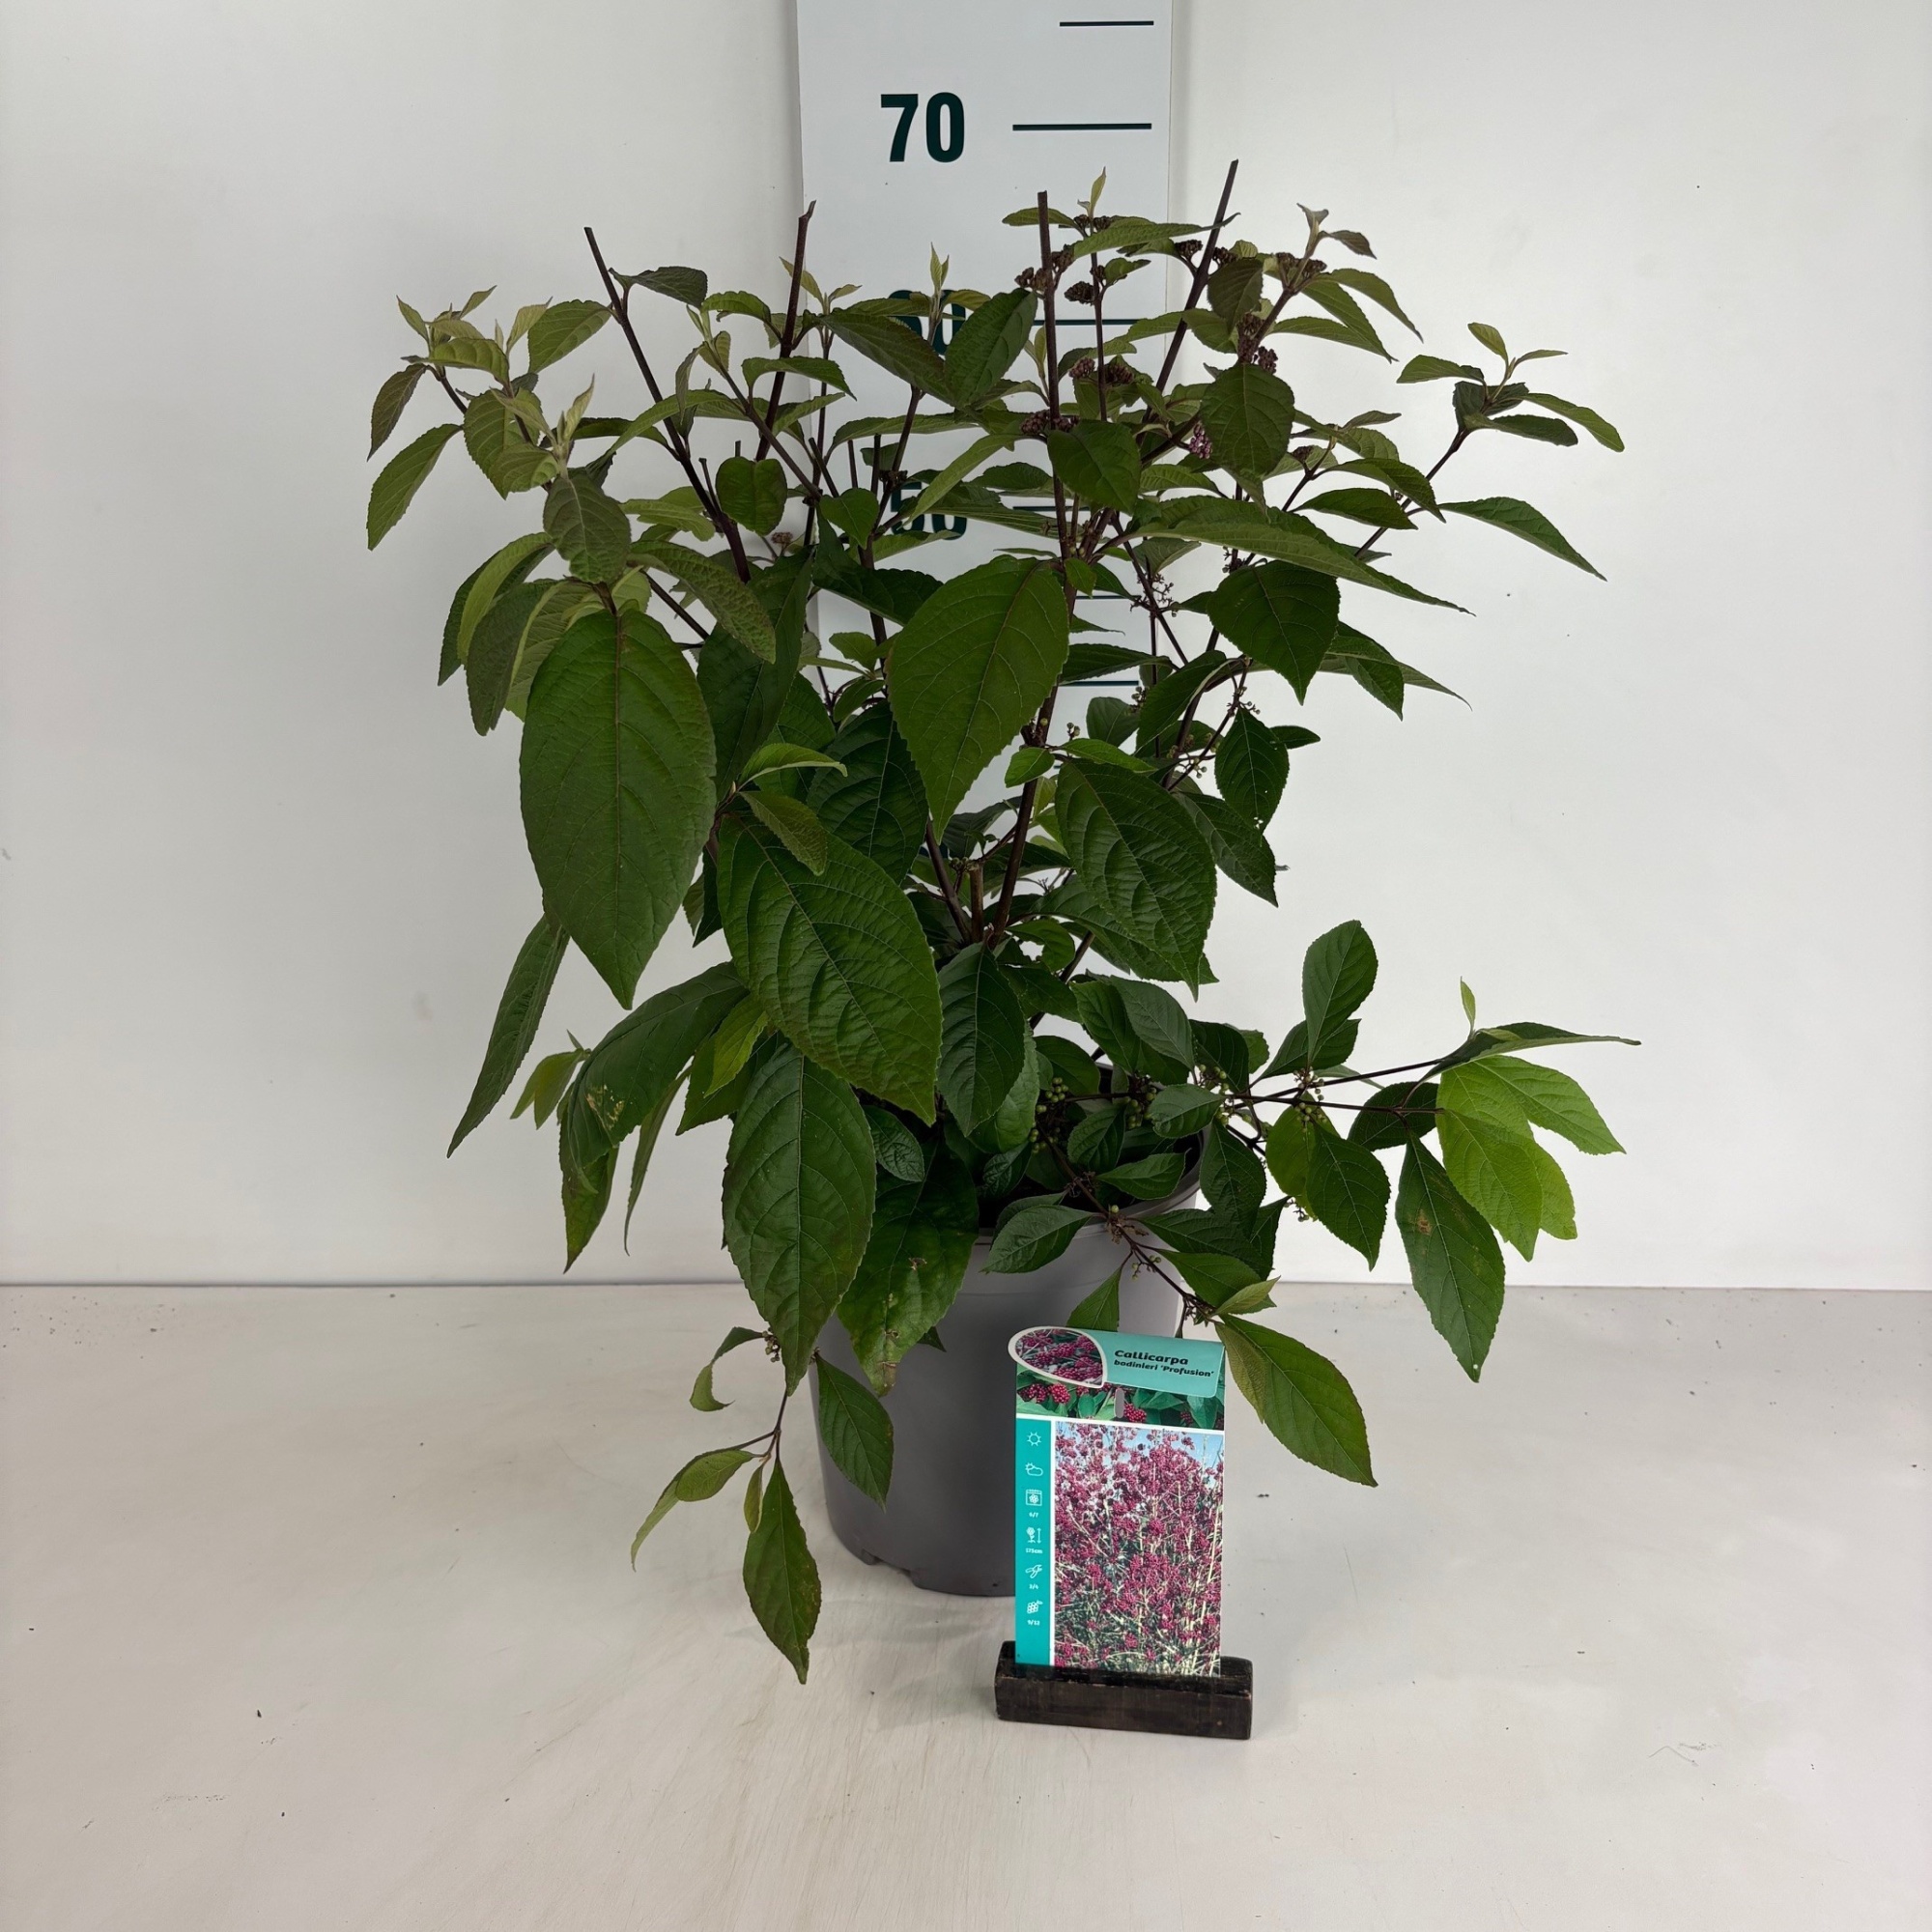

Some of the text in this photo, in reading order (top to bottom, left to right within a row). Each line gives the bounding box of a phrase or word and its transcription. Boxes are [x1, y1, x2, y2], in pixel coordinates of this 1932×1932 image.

[880, 92, 965, 163] 70
[1114, 1350, 1189, 1365] Callicarpa
[1114, 1359, 1214, 1378] bodinieri 'Profusion'
